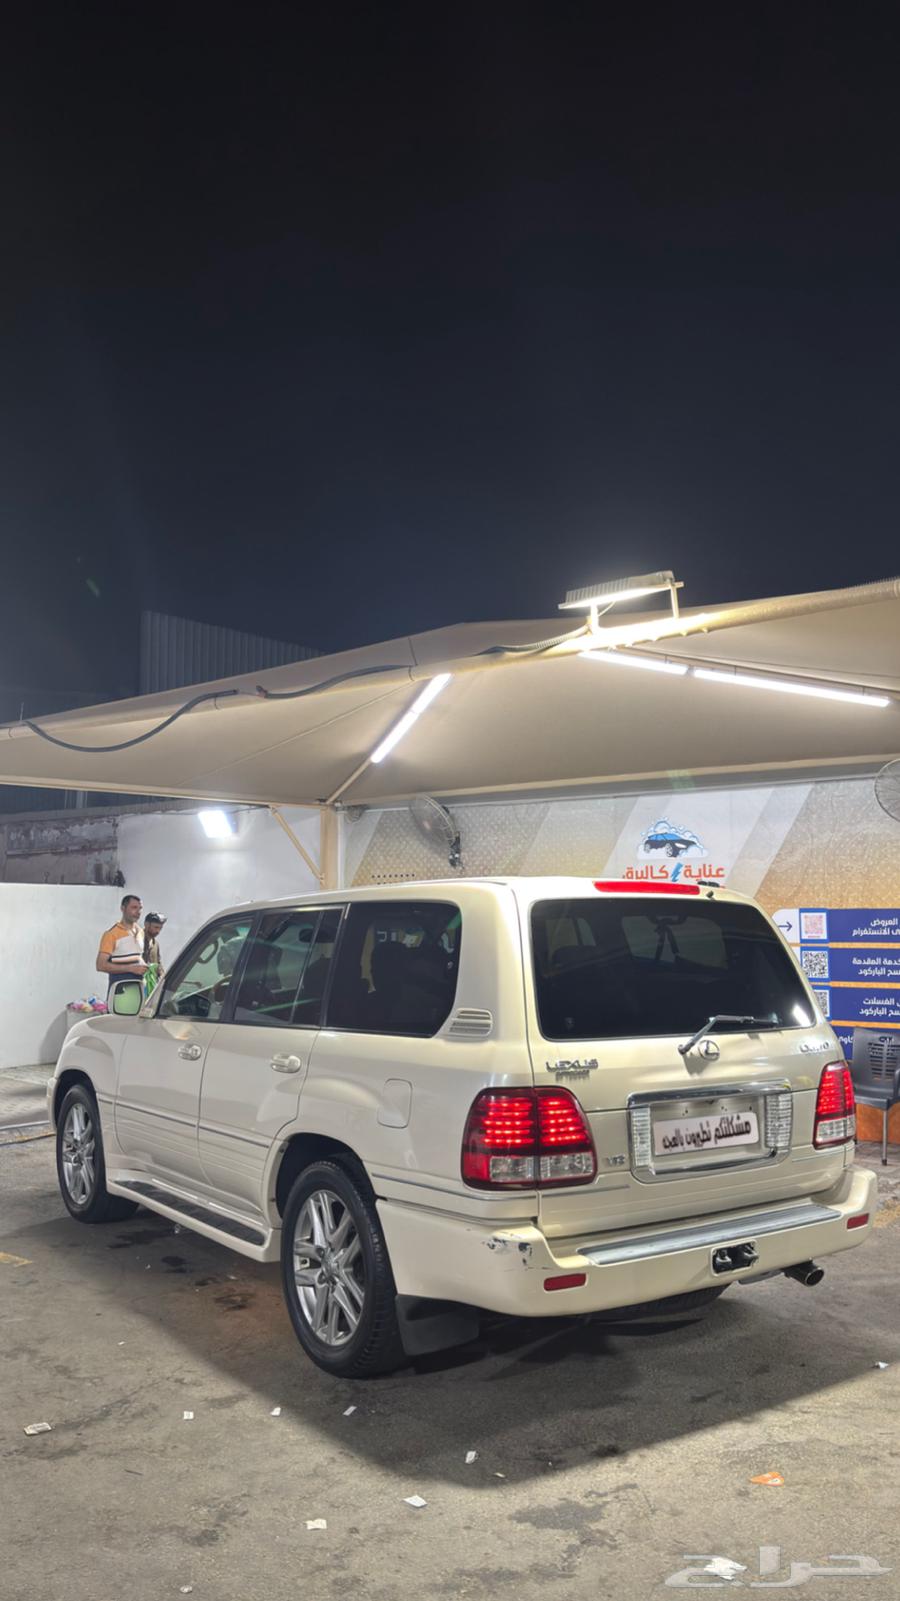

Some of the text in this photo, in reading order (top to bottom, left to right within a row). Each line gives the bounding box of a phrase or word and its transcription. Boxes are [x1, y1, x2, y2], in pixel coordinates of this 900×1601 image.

[683, 864, 725, 879] عناية
[870, 918, 898, 927] العروض
[858, 967, 886, 977] الباركود
[859, 1007, 888, 1017] الباركود
[545, 1058, 598, 1073] LEXUS
